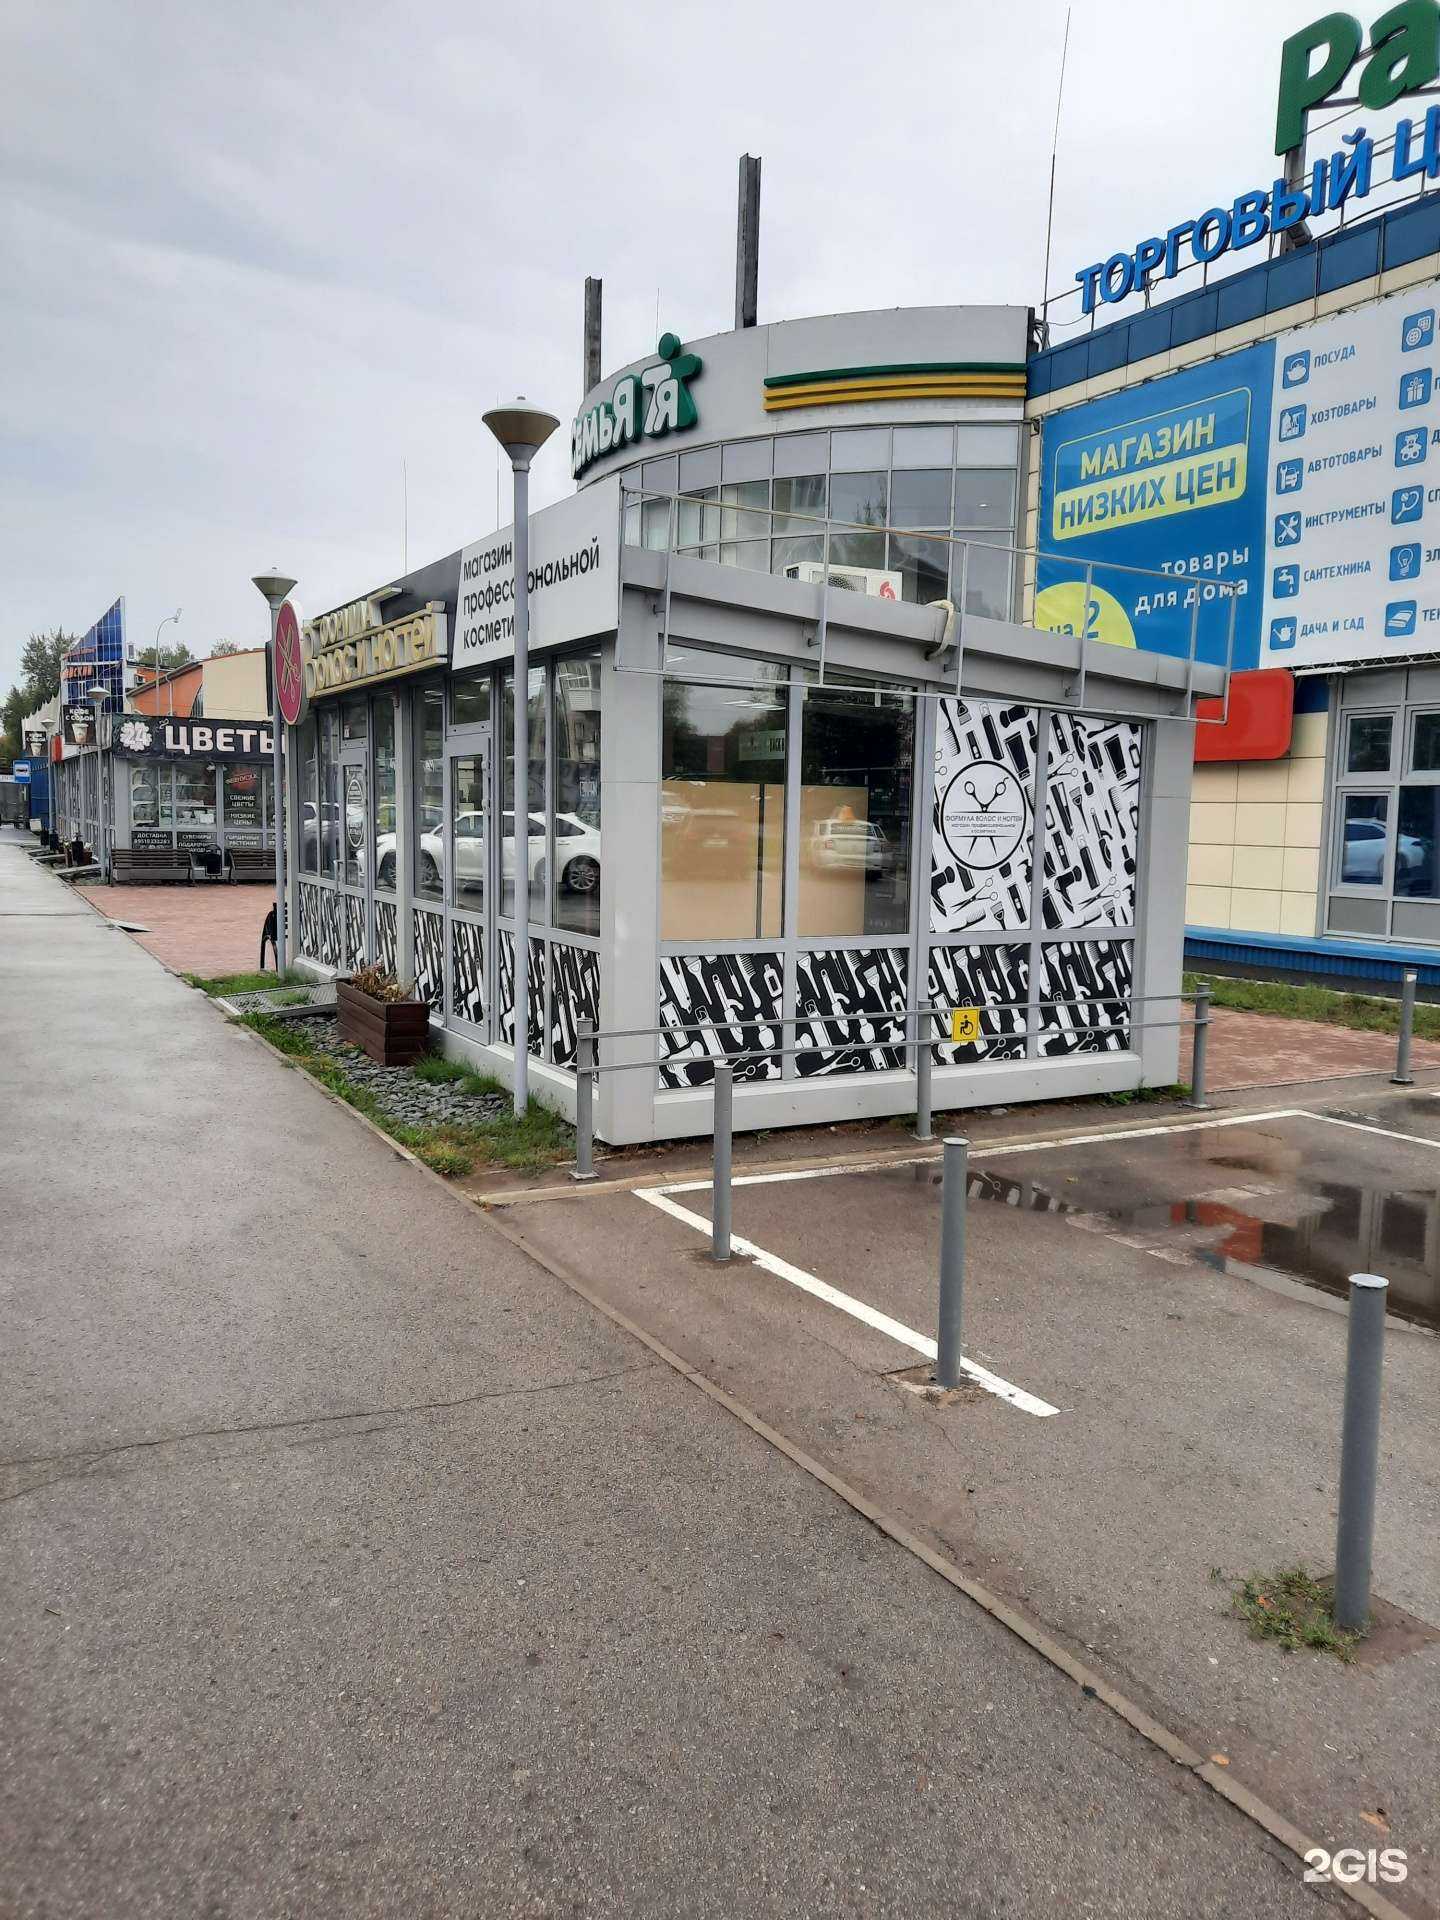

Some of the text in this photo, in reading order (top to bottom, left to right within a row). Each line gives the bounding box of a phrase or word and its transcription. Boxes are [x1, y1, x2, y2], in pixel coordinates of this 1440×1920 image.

[1075, 127, 1373, 315] ТОРГОВЫЙ
[1314, 345, 1356, 368] ПОСУДА
[1310, 396, 1377, 425] ХОЗТОВАРЫ
[1080, 412, 1215, 480] МАГАЗИН
[1307, 444, 1383, 473] АВТОТОВАРЫ
[1060, 457, 1237, 530] НИЗКИХ ЦЕН
[1305, 501, 1385, 528] ИНСТРУМЕНТЫ
[463, 541, 512, 582] магазин
[1161, 547, 1249, 576] товары
[1303, 561, 1372, 582] САНТЕХНИКА
[463, 535, 600, 620] професональной
[1135, 579, 1249, 617] для дома
[463, 609, 530, 650] космети
[1300, 617, 1365, 638] ДАЧА И САД
[165, 725, 286, 755] ЦВЕТЫ
